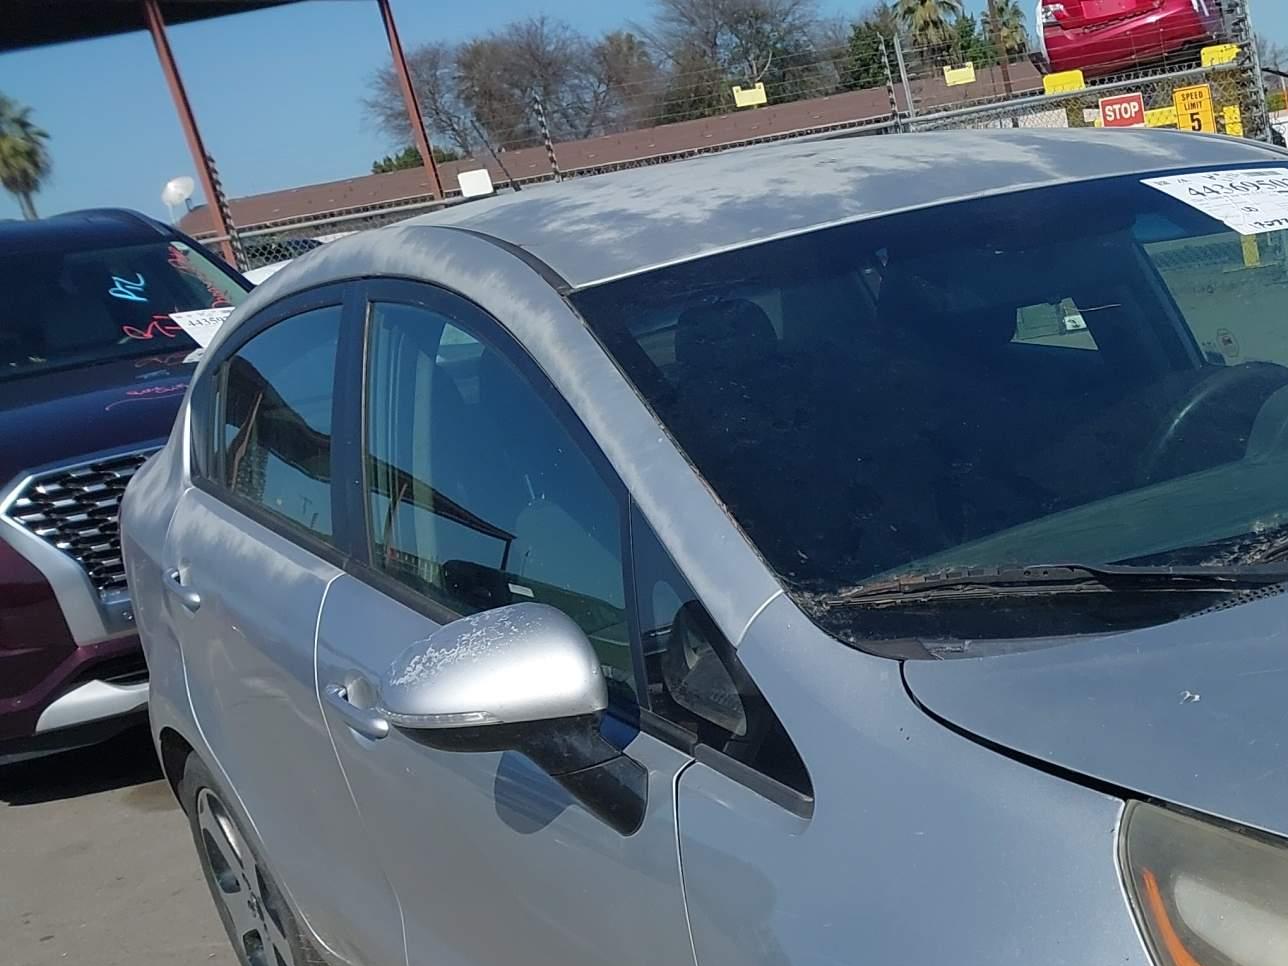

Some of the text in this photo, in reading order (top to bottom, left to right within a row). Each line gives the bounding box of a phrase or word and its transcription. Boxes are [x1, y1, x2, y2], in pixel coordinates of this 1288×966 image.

[1181, 91, 1204, 101] SPEED
[1104, 102, 1139, 121] STOP
[1183, 101, 1202, 111] LIMIT
[1190, 112, 1202, 131] 5
